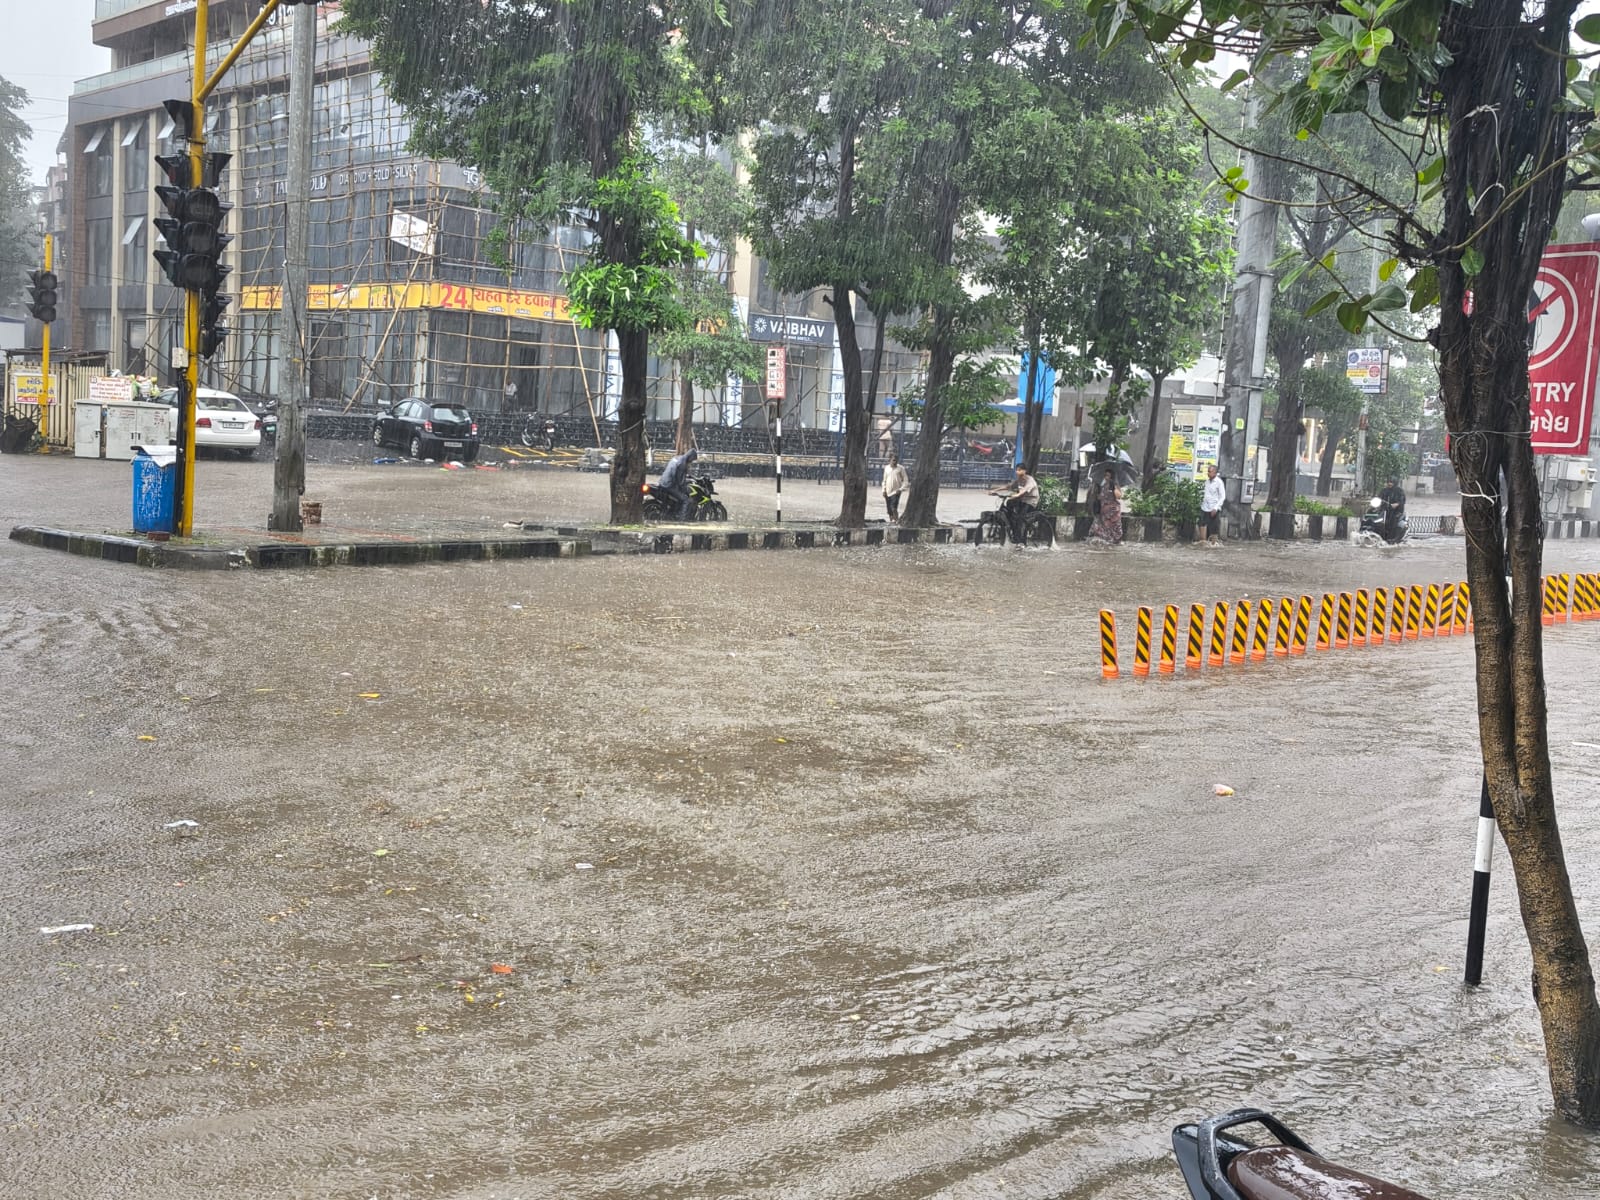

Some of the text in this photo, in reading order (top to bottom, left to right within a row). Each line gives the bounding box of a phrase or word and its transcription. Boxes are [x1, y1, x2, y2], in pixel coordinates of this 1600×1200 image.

[339, 171, 366, 185] DIAOND
[440, 283, 468, 309] 24
[770, 320, 825, 338] VAIBHAV
[1532, 382, 1576, 403] TRY
